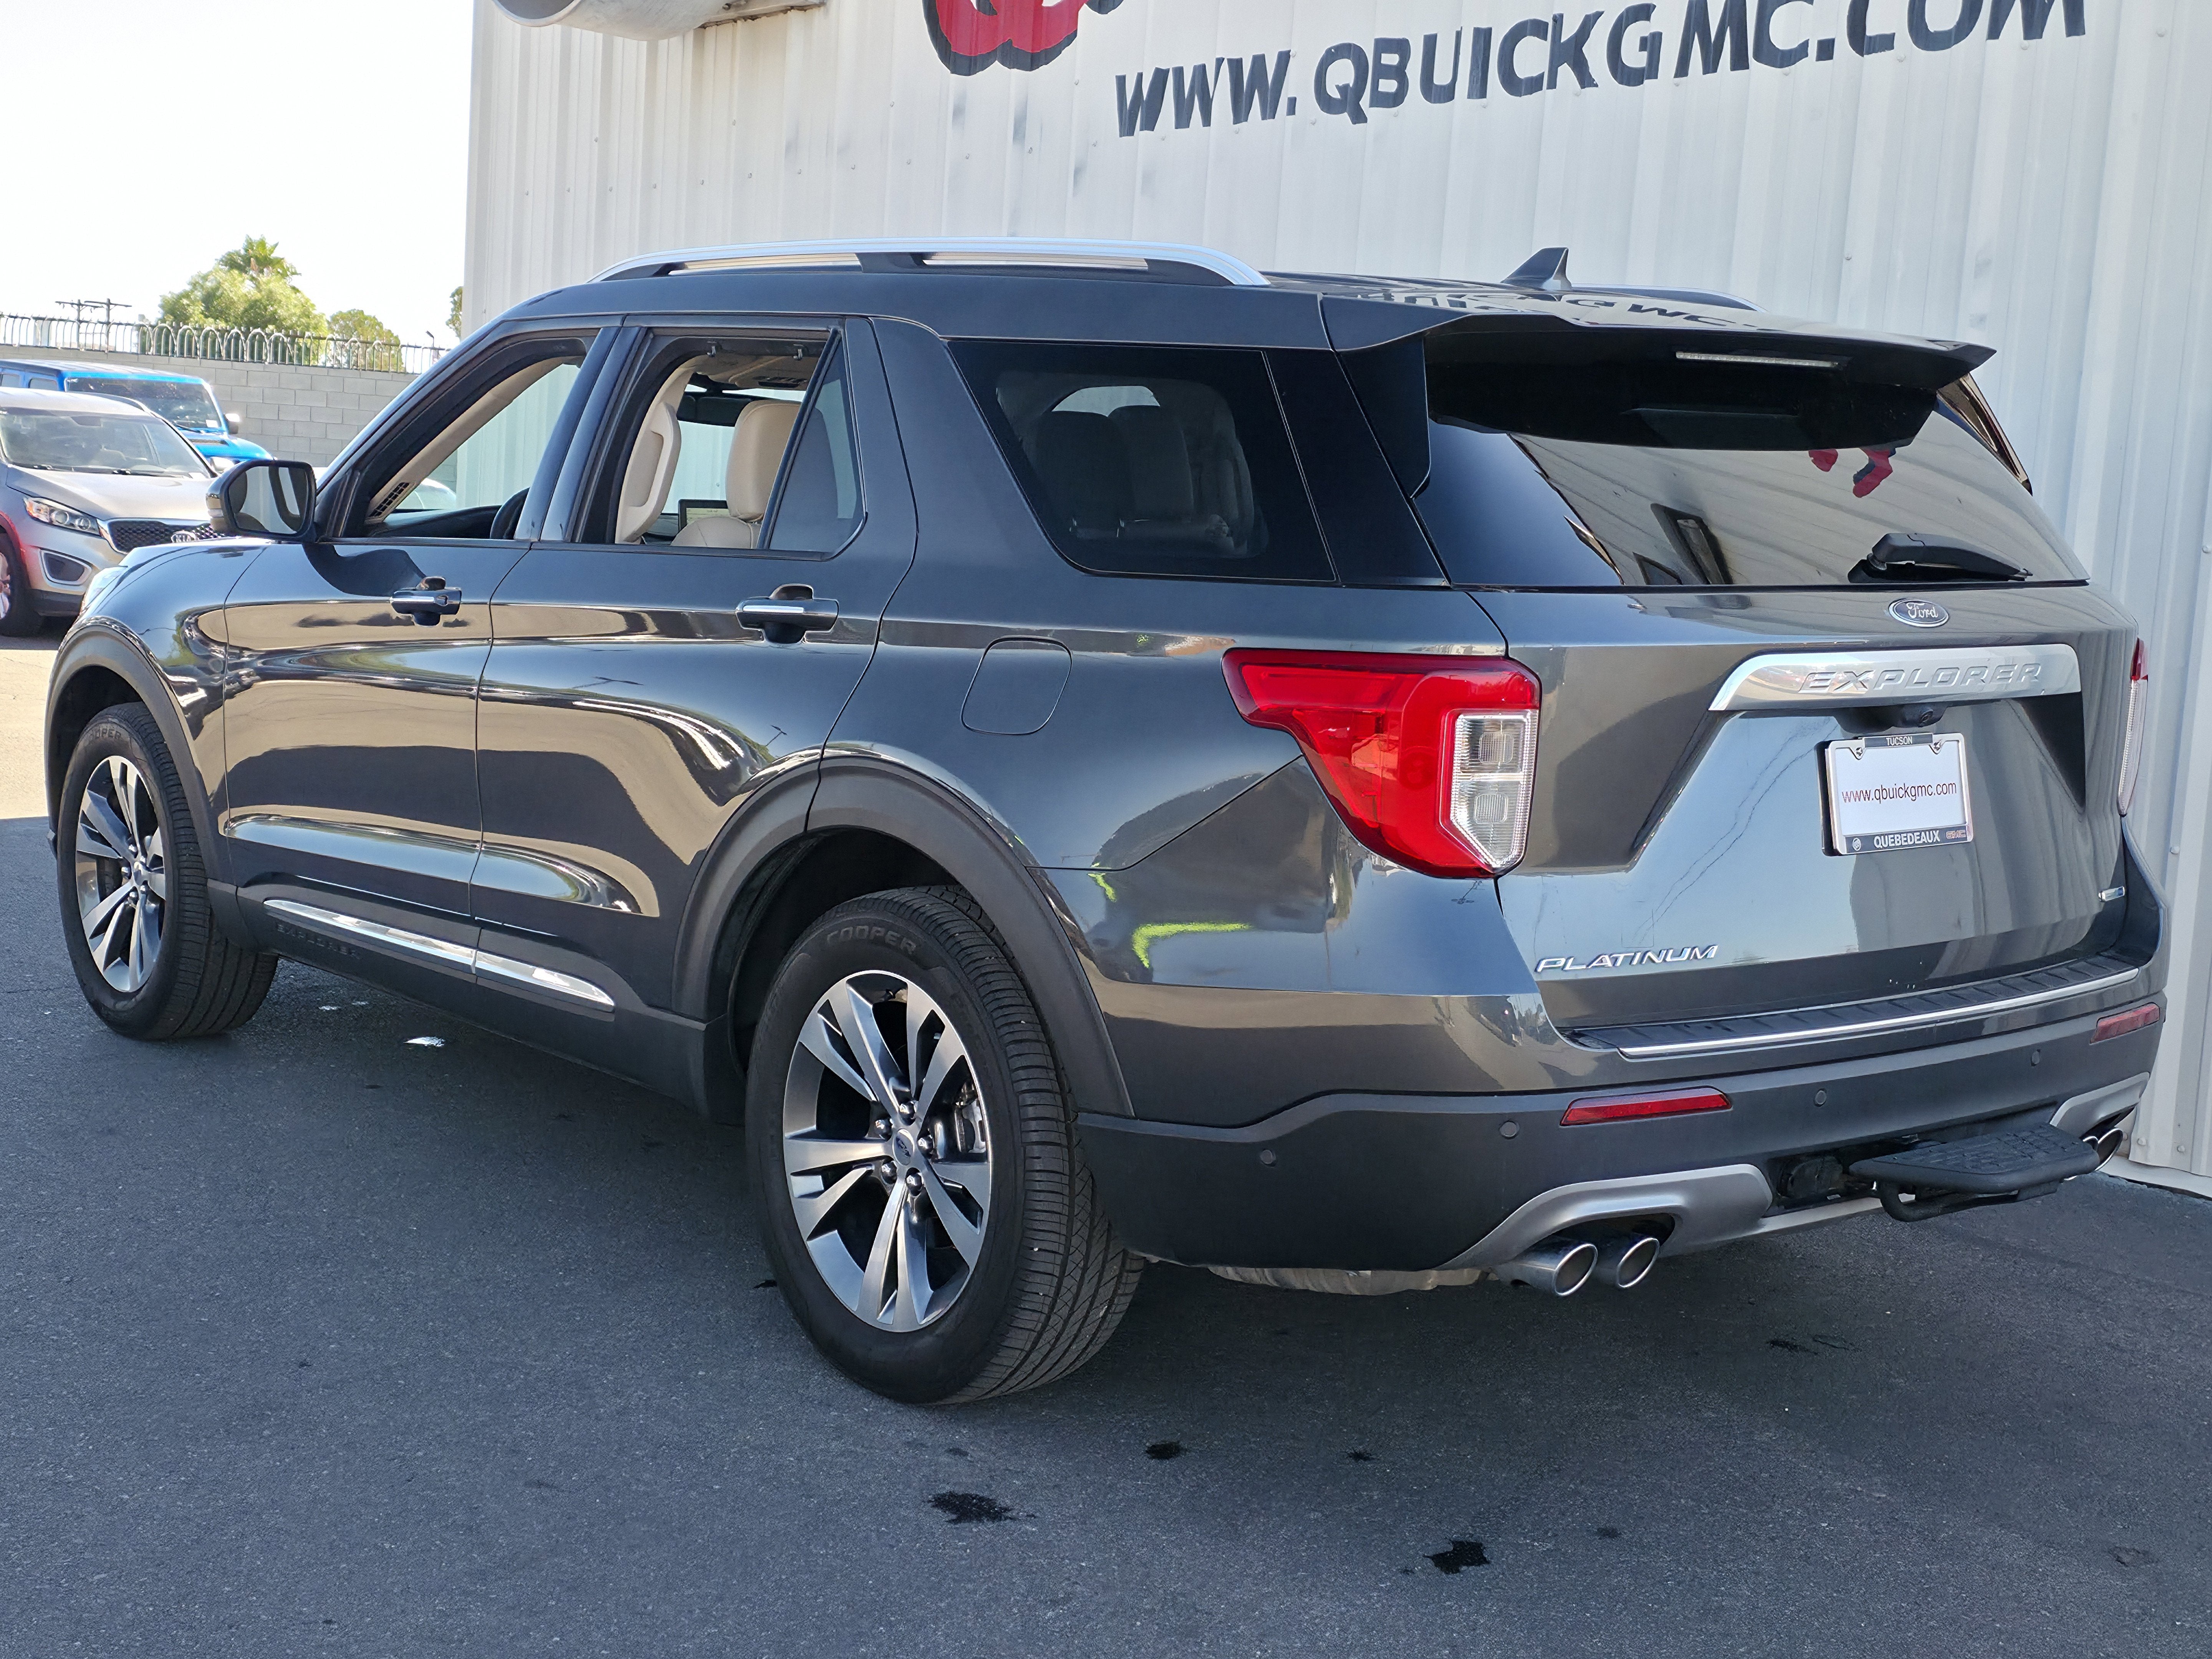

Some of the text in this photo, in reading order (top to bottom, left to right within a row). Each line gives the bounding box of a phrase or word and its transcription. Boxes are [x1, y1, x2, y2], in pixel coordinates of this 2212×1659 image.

[1906, 602, 1938, 618] Ford
[1798, 662, 2041, 693] EXPLORER
[1886, 736, 1913, 746] TUCSON
[1842, 783, 1957, 804] www.qbuickgmc.com
[1873, 830, 1966, 849] QUEBEDEAUX GMC
[827, 925, 917, 955] COOPER
[1534, 944, 1719, 974] PLATINUM
